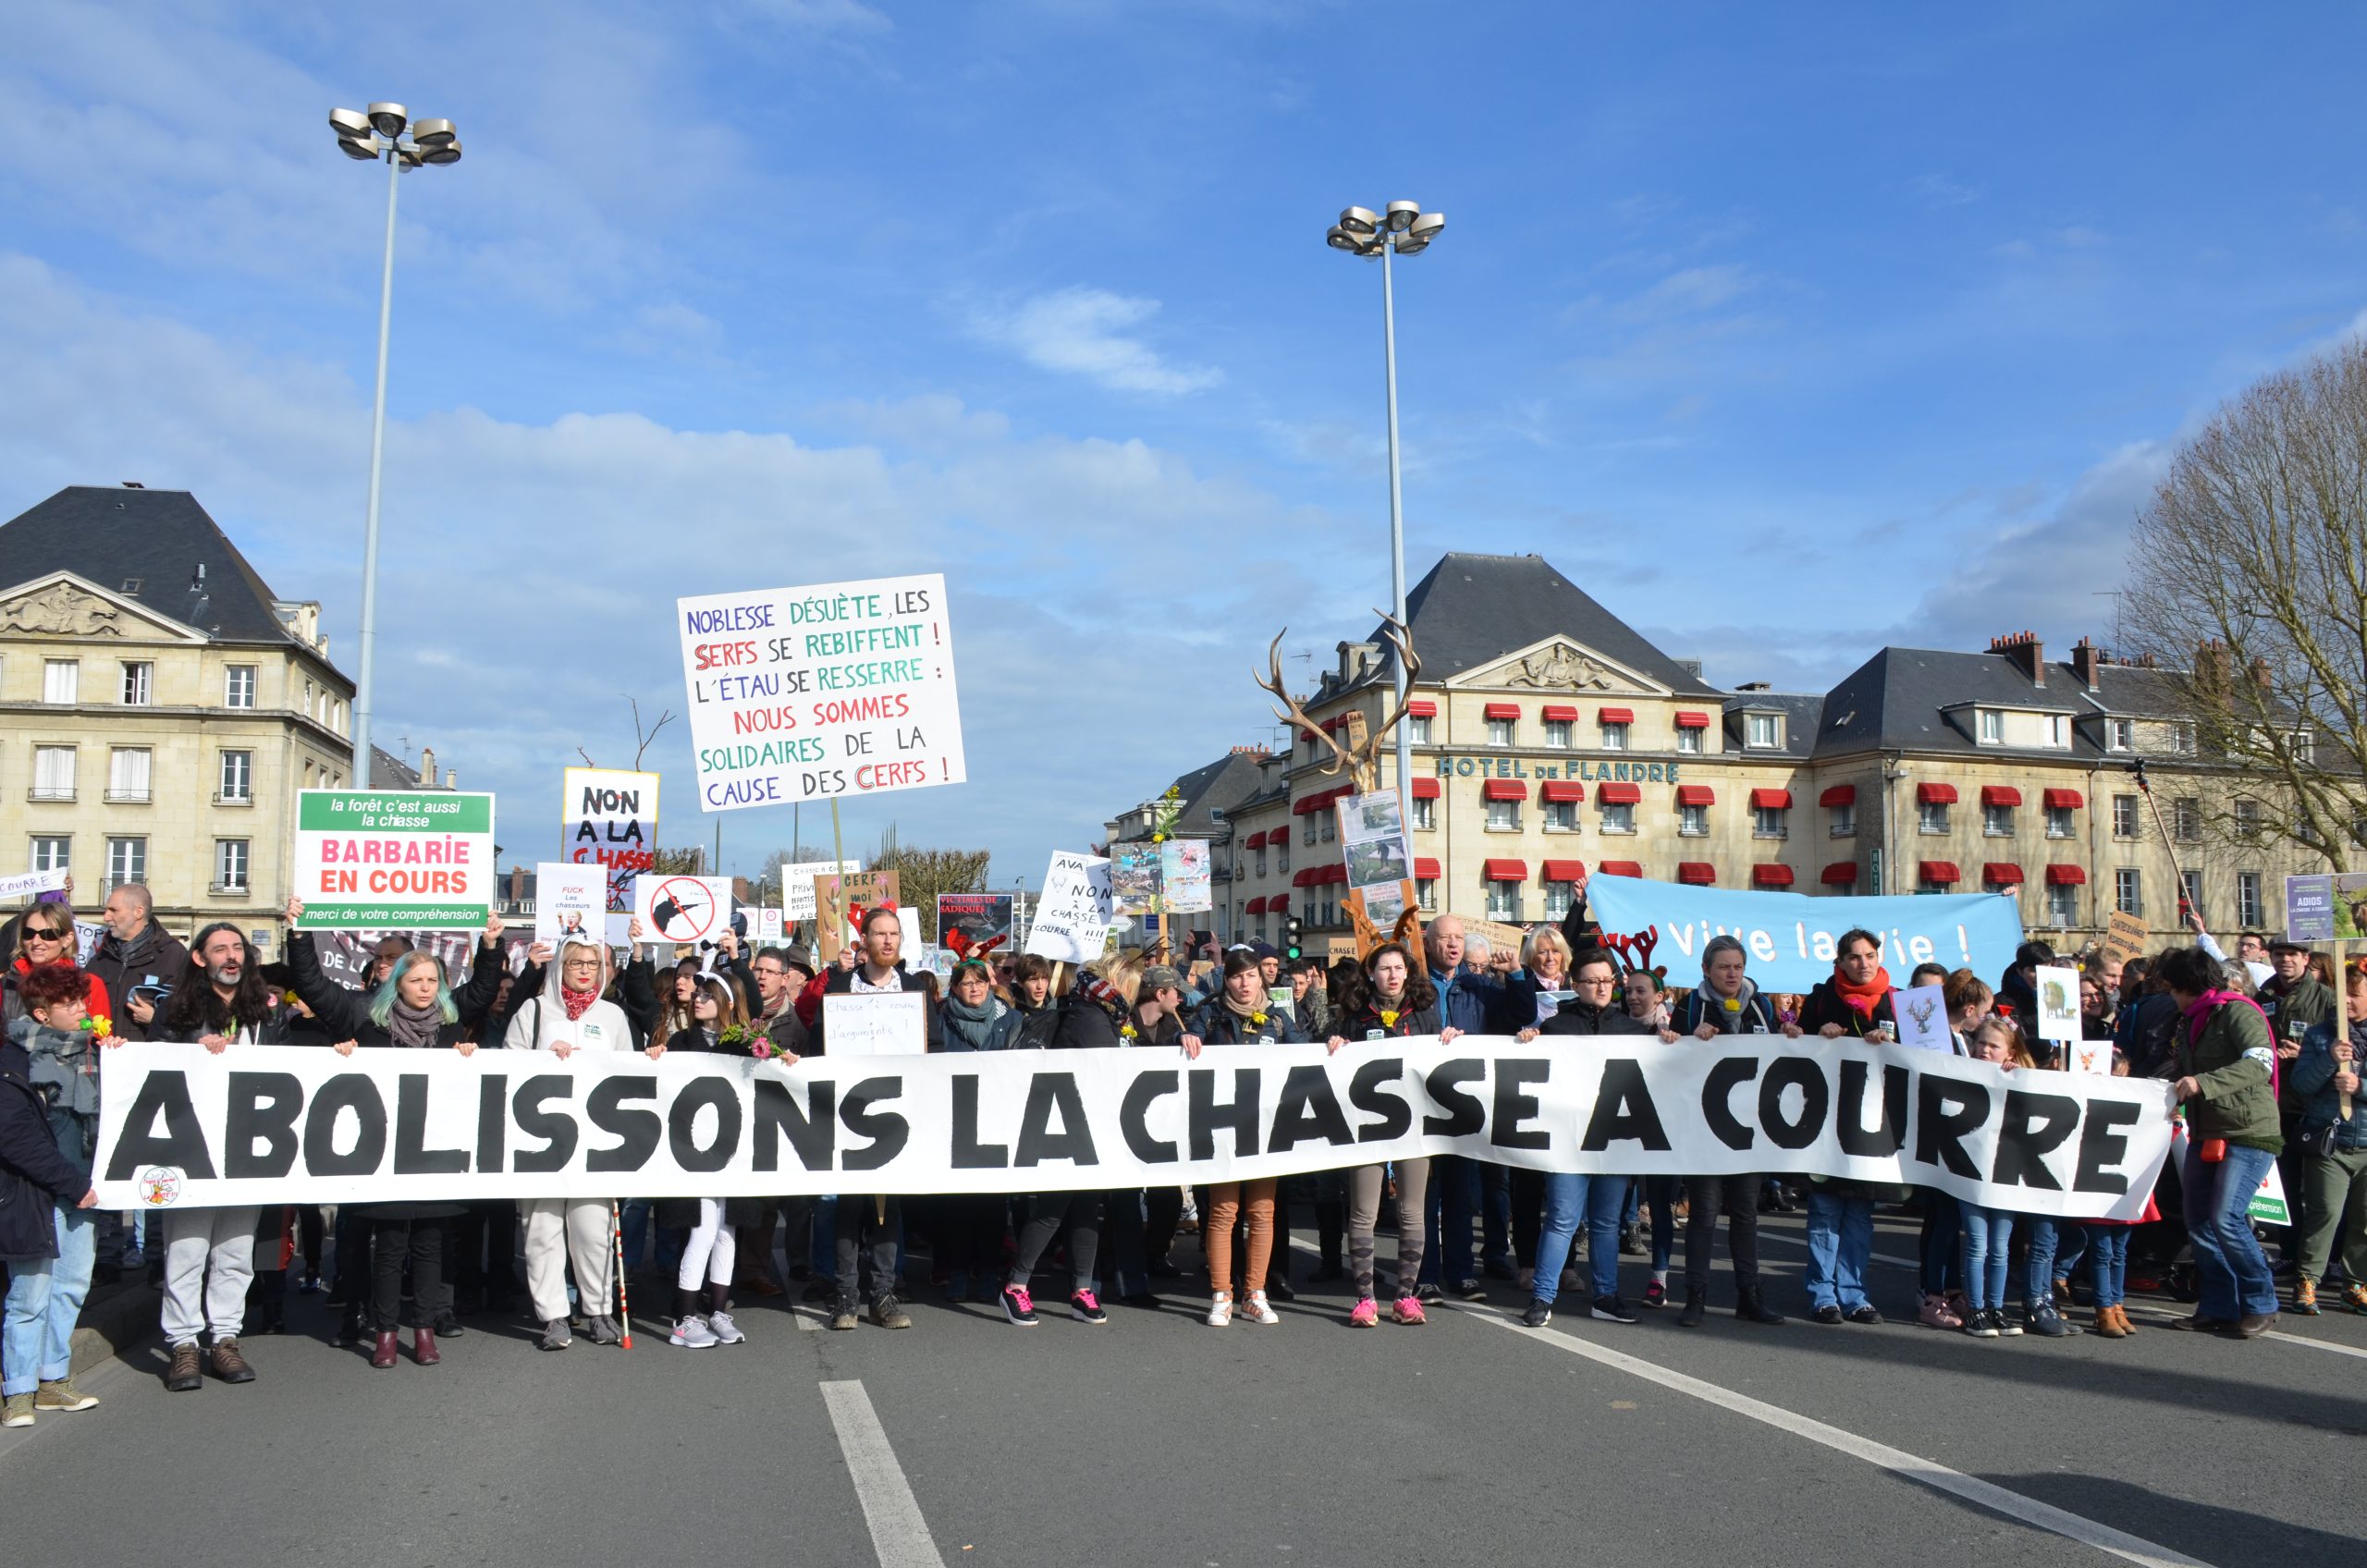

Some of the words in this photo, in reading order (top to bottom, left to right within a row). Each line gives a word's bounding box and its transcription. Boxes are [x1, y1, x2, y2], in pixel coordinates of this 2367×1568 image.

[687, 605, 775, 634] NOBLESSE
[694, 641, 758, 671] SERFS
[768, 637, 792, 663] SE
[805, 624, 924, 657] REBIFFENT
[787, 670, 810, 693] SE
[817, 657, 924, 692] RESSERRE
[733, 705, 796, 735] NOUS
[813, 693, 910, 726] SOMMES
[700, 737, 825, 773] SOLIDAIRES
[845, 731, 873, 756] DE
[897, 726, 926, 750] LA
[1438, 756, 1527, 778] HOTEL
[1535, 766, 1557, 778] DE
[1566, 760, 1679, 782] FLANDRE
[707, 777, 781, 806] CAUSE
[803, 770, 846, 795] DES
[854, 760, 926, 790] CERFS
[331, 799, 343, 812] la
[348, 799, 381, 813] forêt
[386, 801, 420, 814] c'est
[424, 801, 461, 814] aussi
[583, 787, 639, 815] NON
[362, 814, 374, 827] la
[576, 820, 598, 842] A
[607, 819, 644, 842] LA
[320, 870, 358, 893] EN
[369, 870, 468, 894] COURS
[844, 874, 877, 887] CERF
[1871, 852, 1880, 895] HOTE
[940, 896, 983, 904] VICTIMES
[1072, 885, 1112, 900] NON
[939, 905, 986, 913] SADIQUES
[1088, 905, 1106, 914] LA
[2297, 897, 2323, 907] ADIOS
[306, 909, 339, 920] merci
[343, 909, 356, 920] de
[361, 911, 388, 921] votre
[394, 909, 479, 923] compréhension
[1050, 909, 1098, 925] CHASSE
[76, 925, 104, 938] TOP
[1035, 925, 1071, 937] COURRE
[323, 950, 346, 970] DE
[104, 1070, 910, 1182] ABOLISSONS
[950, 1072, 1099, 1169] LA
[1120, 1058, 1551, 1164] CHASSE
[1581, 1059, 1673, 1152] A
[1702, 1056, 2141, 1195] COURRE
[2249, 1200, 2282, 1214] préhension
